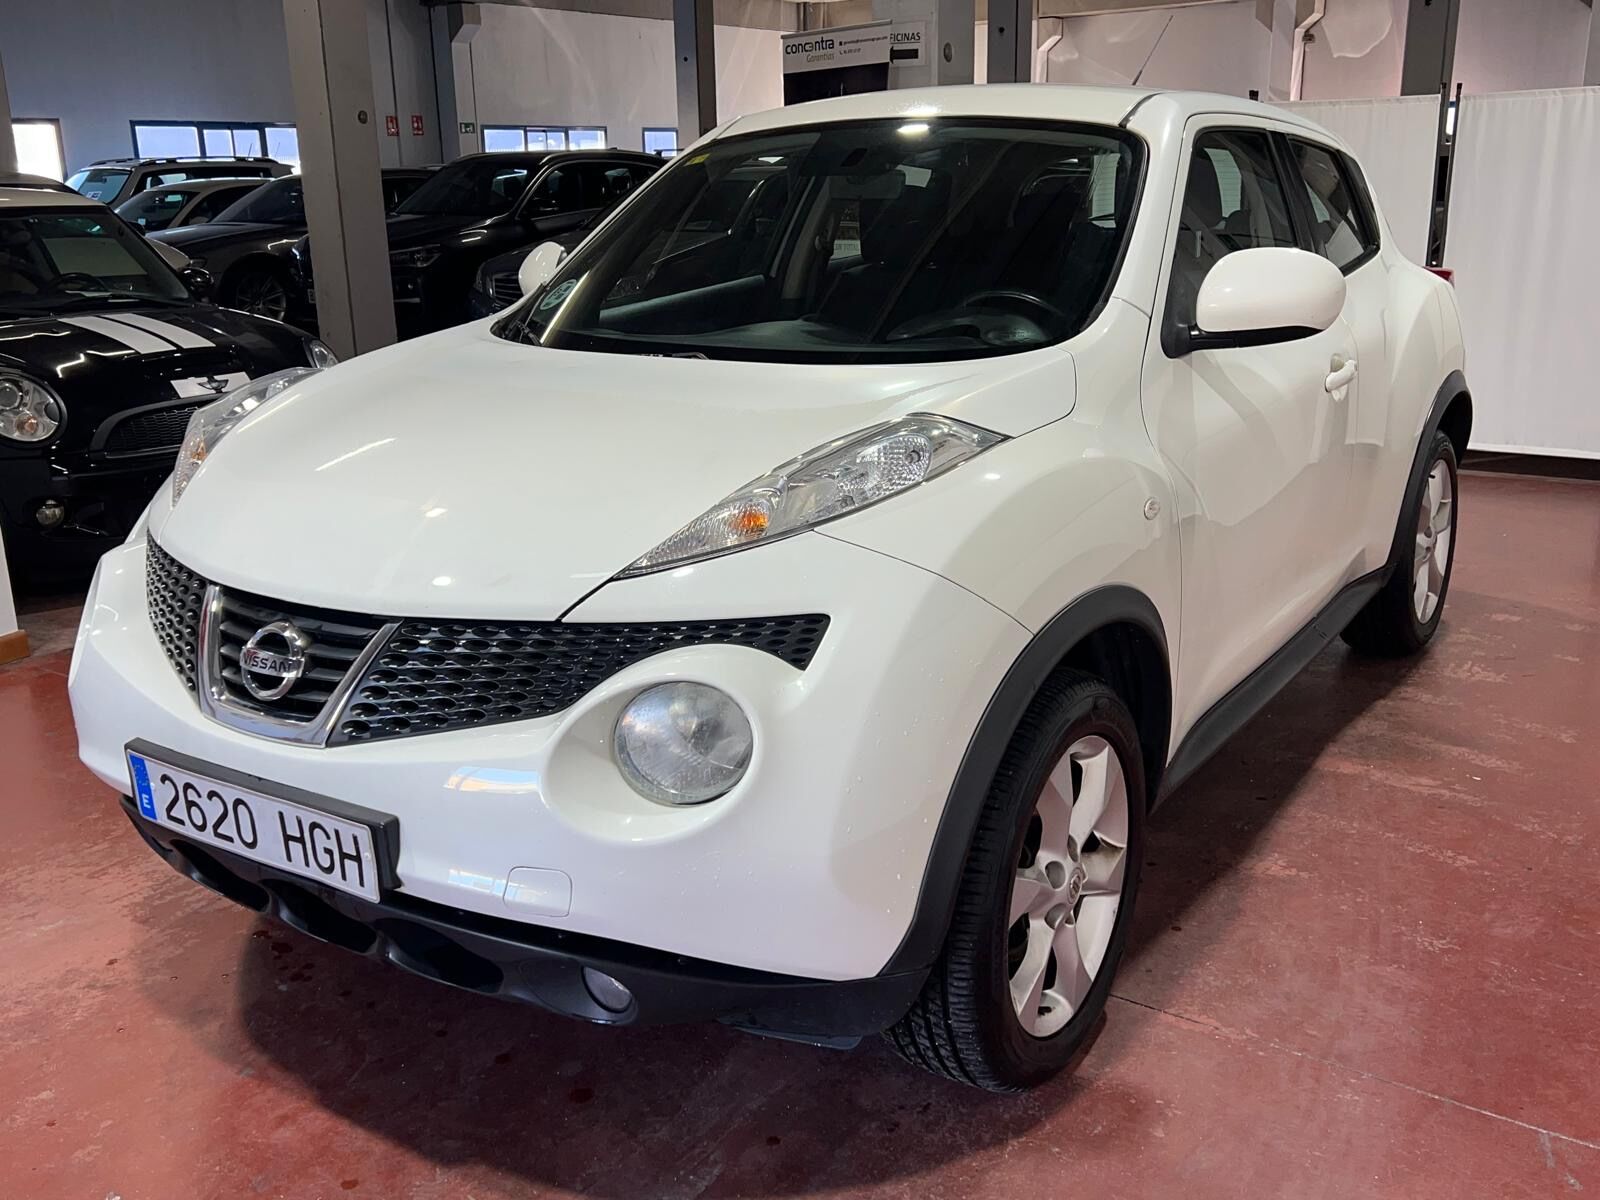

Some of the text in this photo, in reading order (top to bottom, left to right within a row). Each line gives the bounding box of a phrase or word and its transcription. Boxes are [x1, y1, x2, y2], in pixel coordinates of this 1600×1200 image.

[889, 32, 921, 42] FICINAS
[243, 650, 292, 673] NISSAN
[141, 793, 151, 809] E
[160, 773, 365, 888] 2620 HGH
